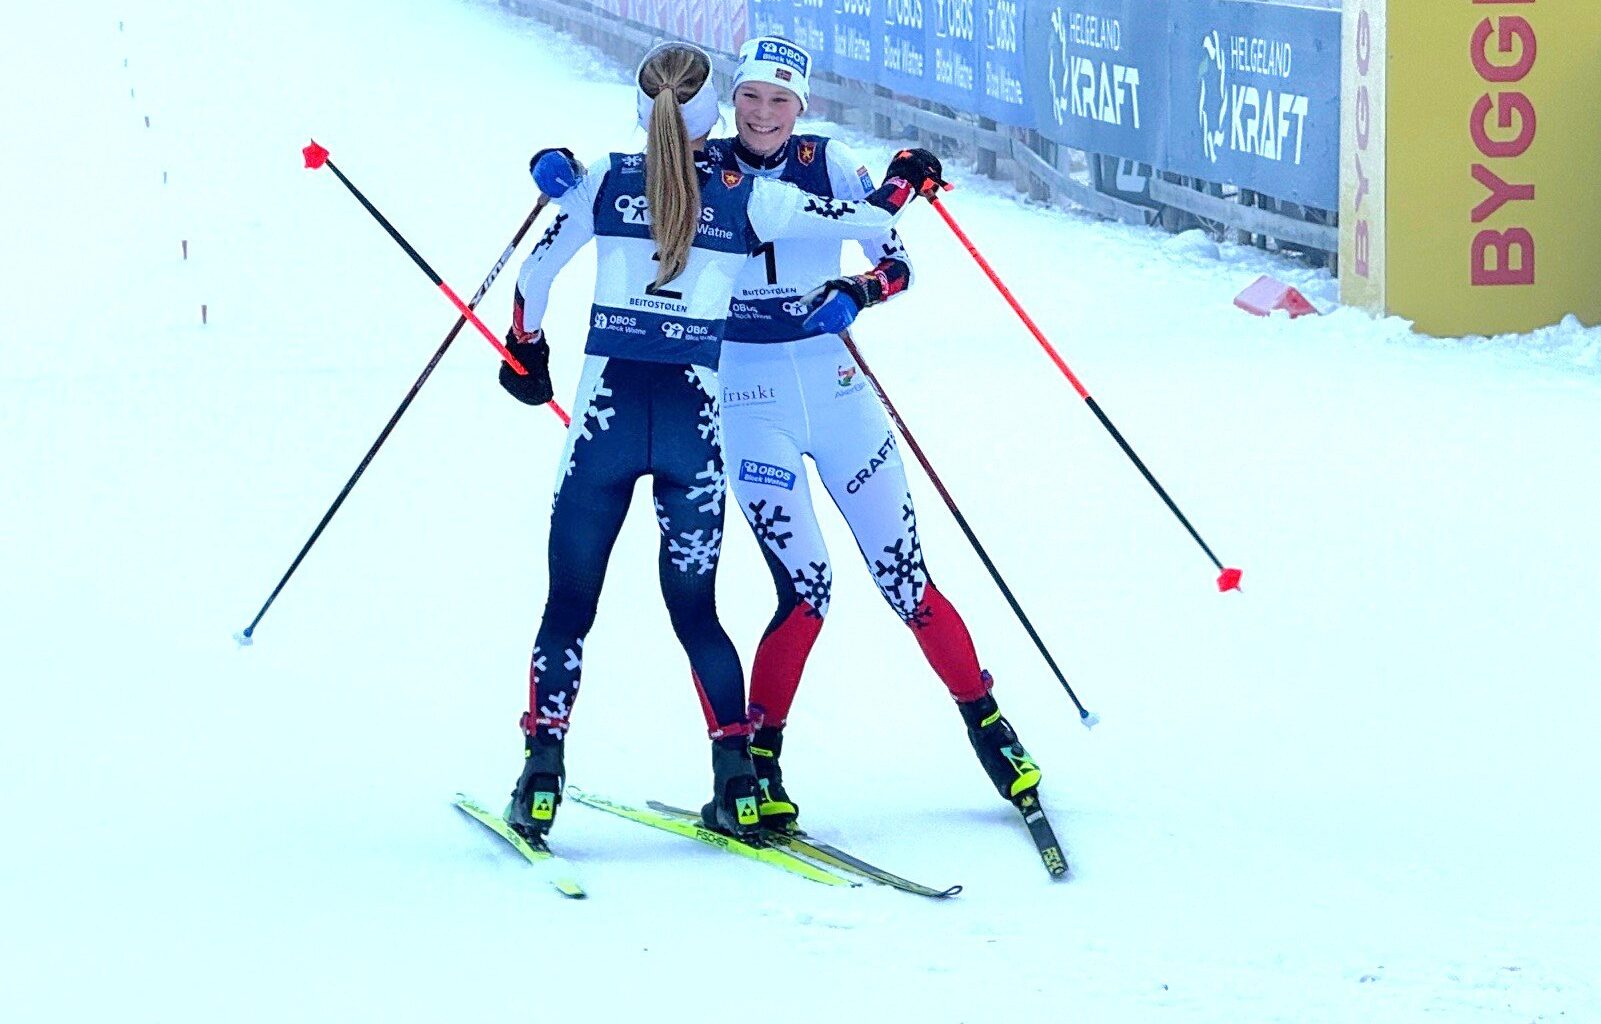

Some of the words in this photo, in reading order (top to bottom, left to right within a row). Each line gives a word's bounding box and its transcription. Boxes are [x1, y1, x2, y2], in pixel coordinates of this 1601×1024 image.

[1069, 13, 1121, 51] HELGELAND
[762, 53, 785, 63] Block
[778, 46, 805, 66] OBOS
[1230, 35, 1292, 78] HELGELAND
[1070, 56, 1140, 129] KRAFT
[1230, 84, 1309, 165] KRAFT
[1355, 9, 1370, 278] BYGG
[1470, 0, 1537, 286] BYGG
[696, 222, 733, 240] Watne
[752, 241, 777, 285] 1
[609, 314, 637, 327] OBOS
[629, 297, 688, 313] BEITOSTØLEN
[758, 465, 792, 482] OBOS
[846, 437, 894, 495] CRAFT
[695, 829, 730, 849] FISCHER
